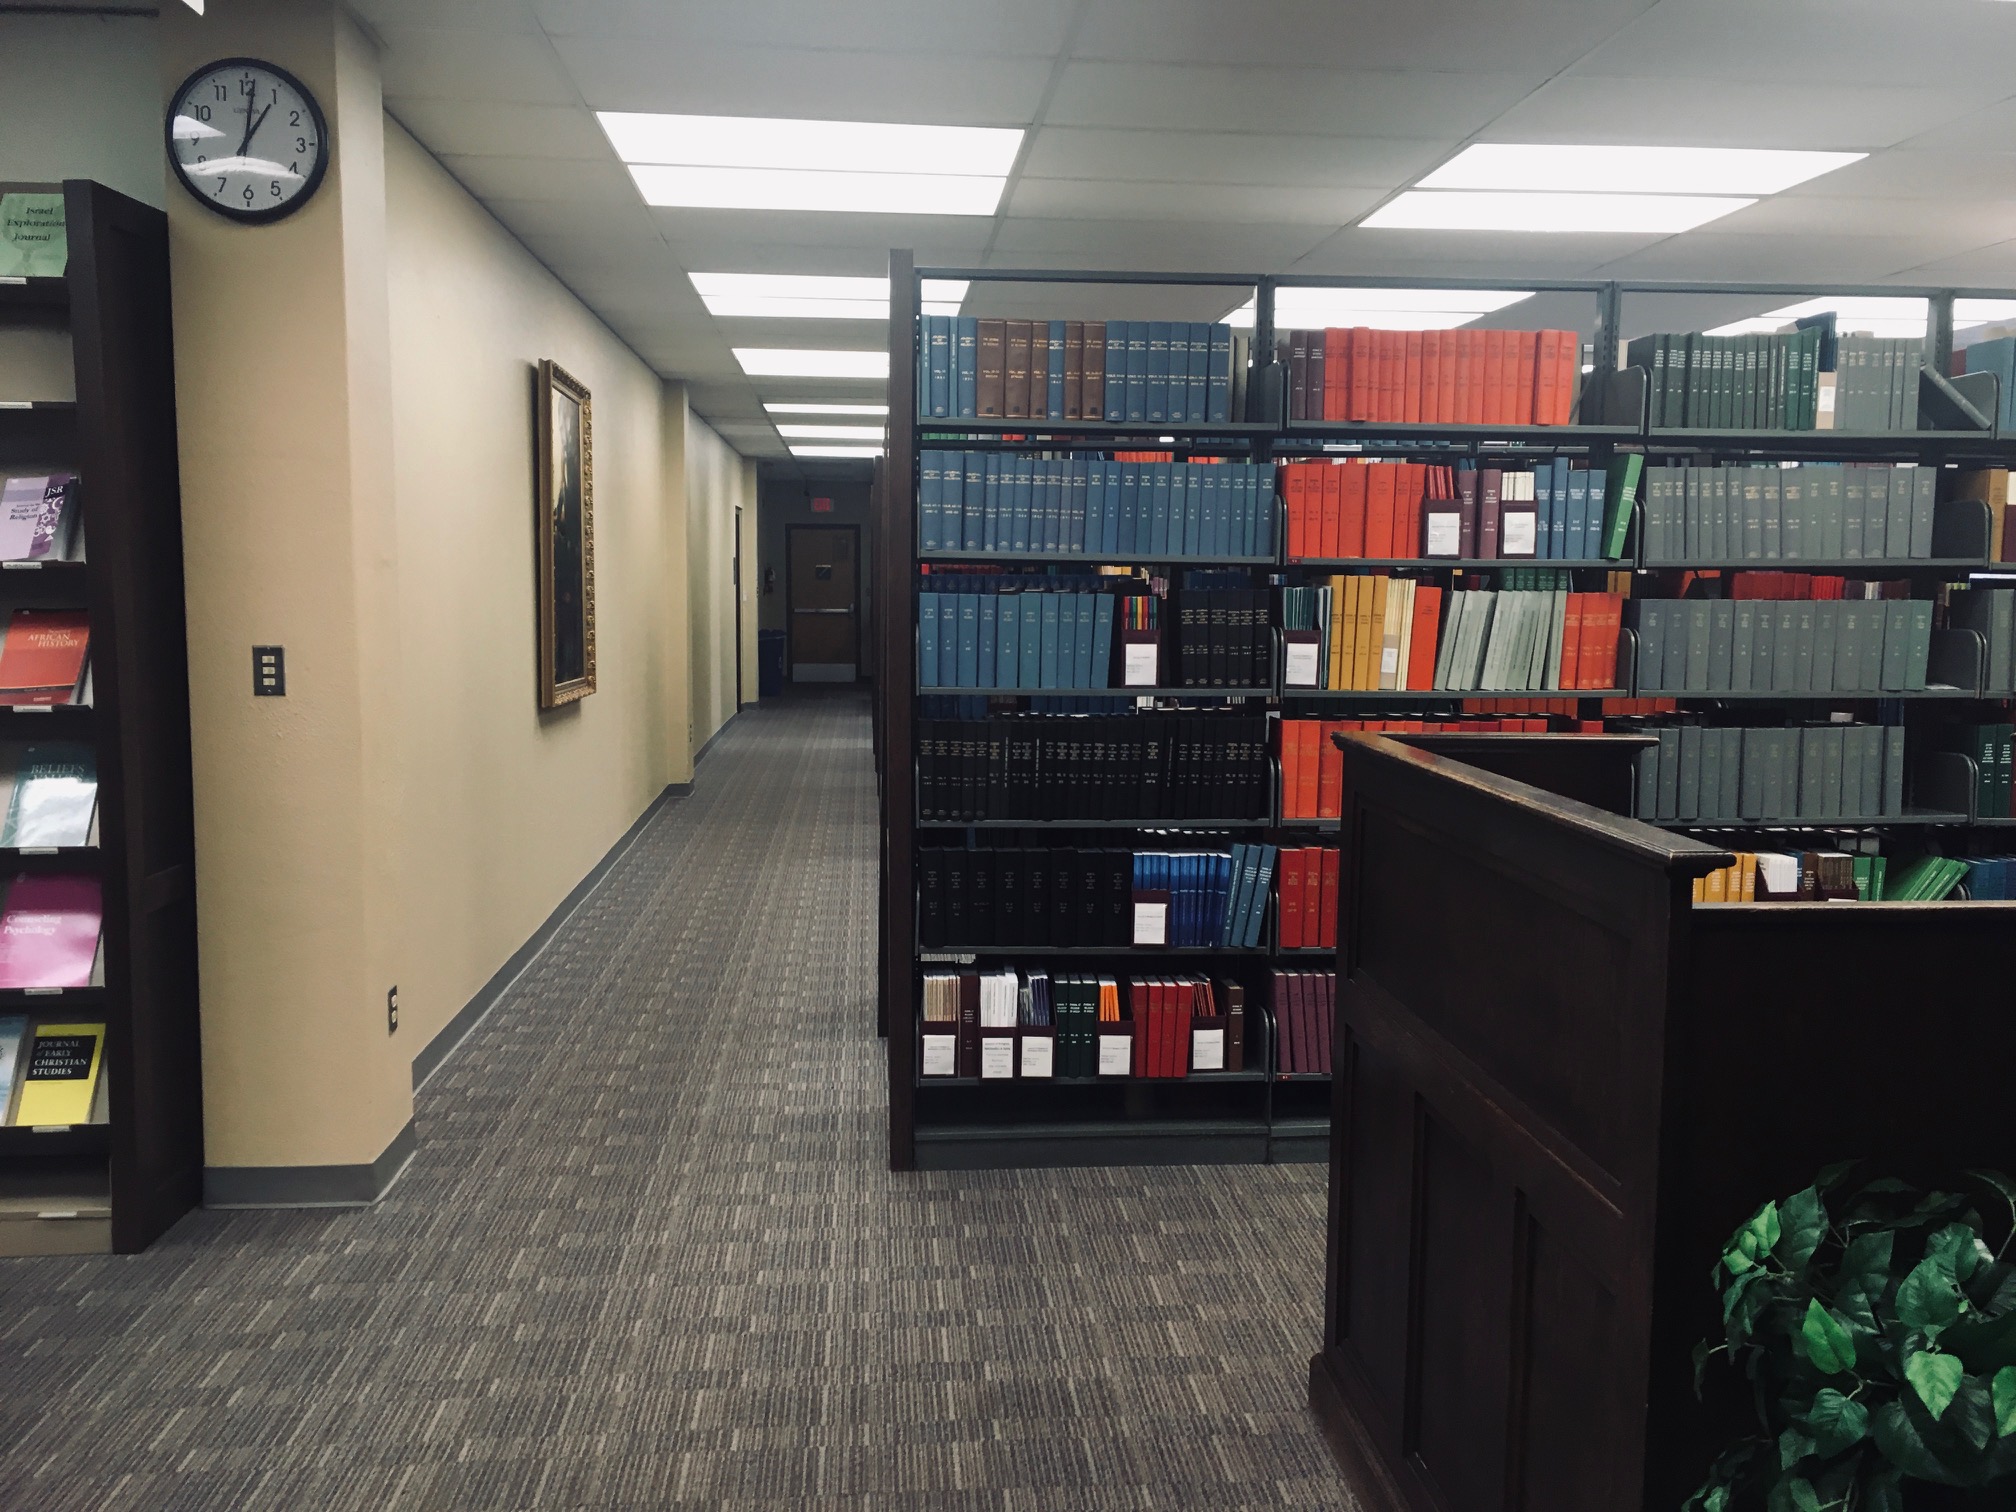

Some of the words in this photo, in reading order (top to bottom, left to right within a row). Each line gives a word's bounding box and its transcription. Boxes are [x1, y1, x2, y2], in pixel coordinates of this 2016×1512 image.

[214, 85, 227, 101] 11
[239, 79, 256, 98] 12
[272, 88, 277, 104] 1
[194, 104, 212, 121] 10
[289, 110, 300, 127] 2
[189, 130, 200, 146] 9
[295, 137, 307, 153] 3
[197, 155, 207, 172] 8
[217, 177, 227, 193] 7
[242, 184, 254, 200] 6
[270, 180, 281, 196] 5
[26, 207, 54, 215] Israel
[7, 219, 65, 228] Exploration
[12, 233, 51, 242] Journal
[44, 485, 64, 498] JSR
[28, 633, 70, 641] AFRICAN
[37, 639, 80, 648] HISTORY
[37, 1040, 80, 1049] JOURNAL
[45, 1049, 73, 1058] EARLY
[34, 1058, 88, 1066] CHRISTIAN
[32, 1067, 73, 1076] STUDIES
